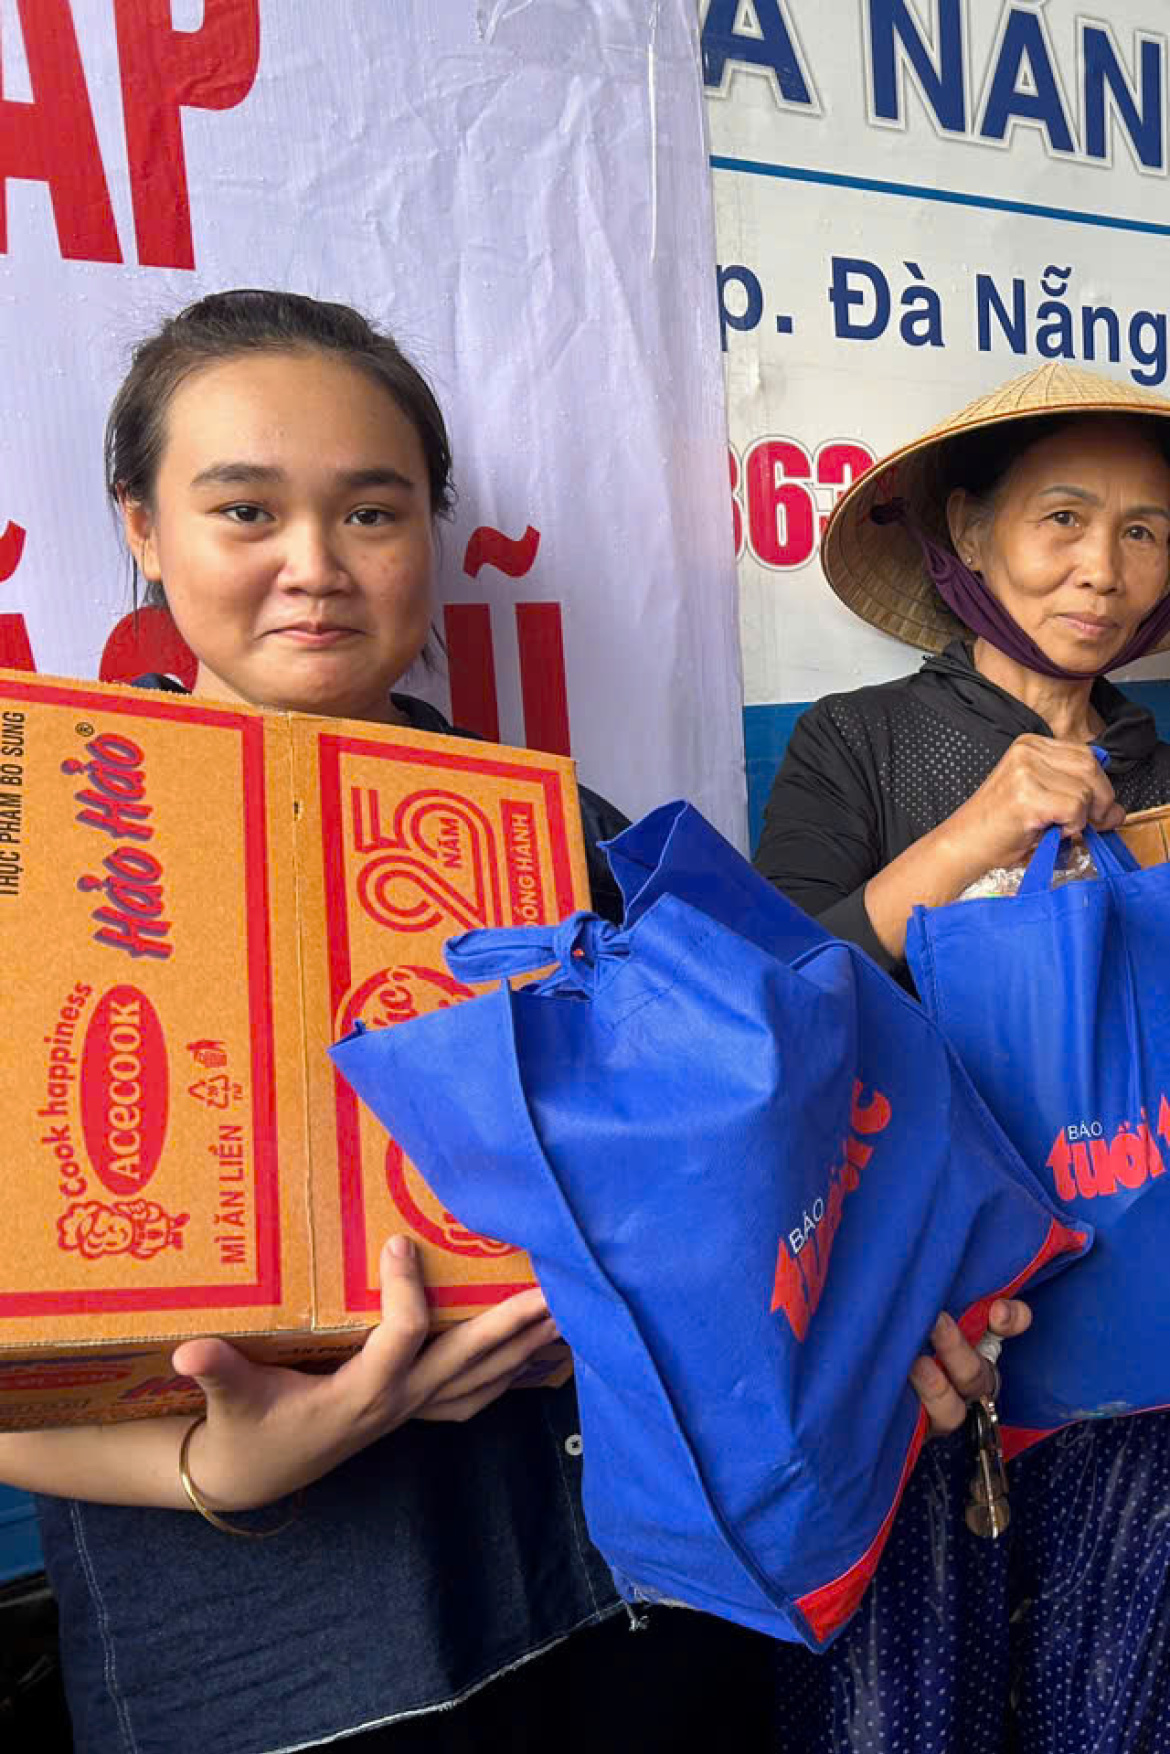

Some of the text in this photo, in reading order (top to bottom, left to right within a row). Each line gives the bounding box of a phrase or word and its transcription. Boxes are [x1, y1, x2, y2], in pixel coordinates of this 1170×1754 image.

[828, 256, 945, 348] Đà
[975, 265, 1168, 387] Nẵng
[1, 711, 25, 757] SUNG
[60, 732, 154, 841] Hảo
[77, 846, 173, 960] Hảo
[350, 787, 504, 933] 25
[38, 982, 93, 1197] Cook happiness
[1067, 1120, 1103, 1141] BÁO
[1046, 1106, 1167, 1202] tuổi
[213, 1191, 246, 1228] ĂN
[213, 1235, 246, 1265] MÌ
[788, 1197, 825, 1255] BÁO
